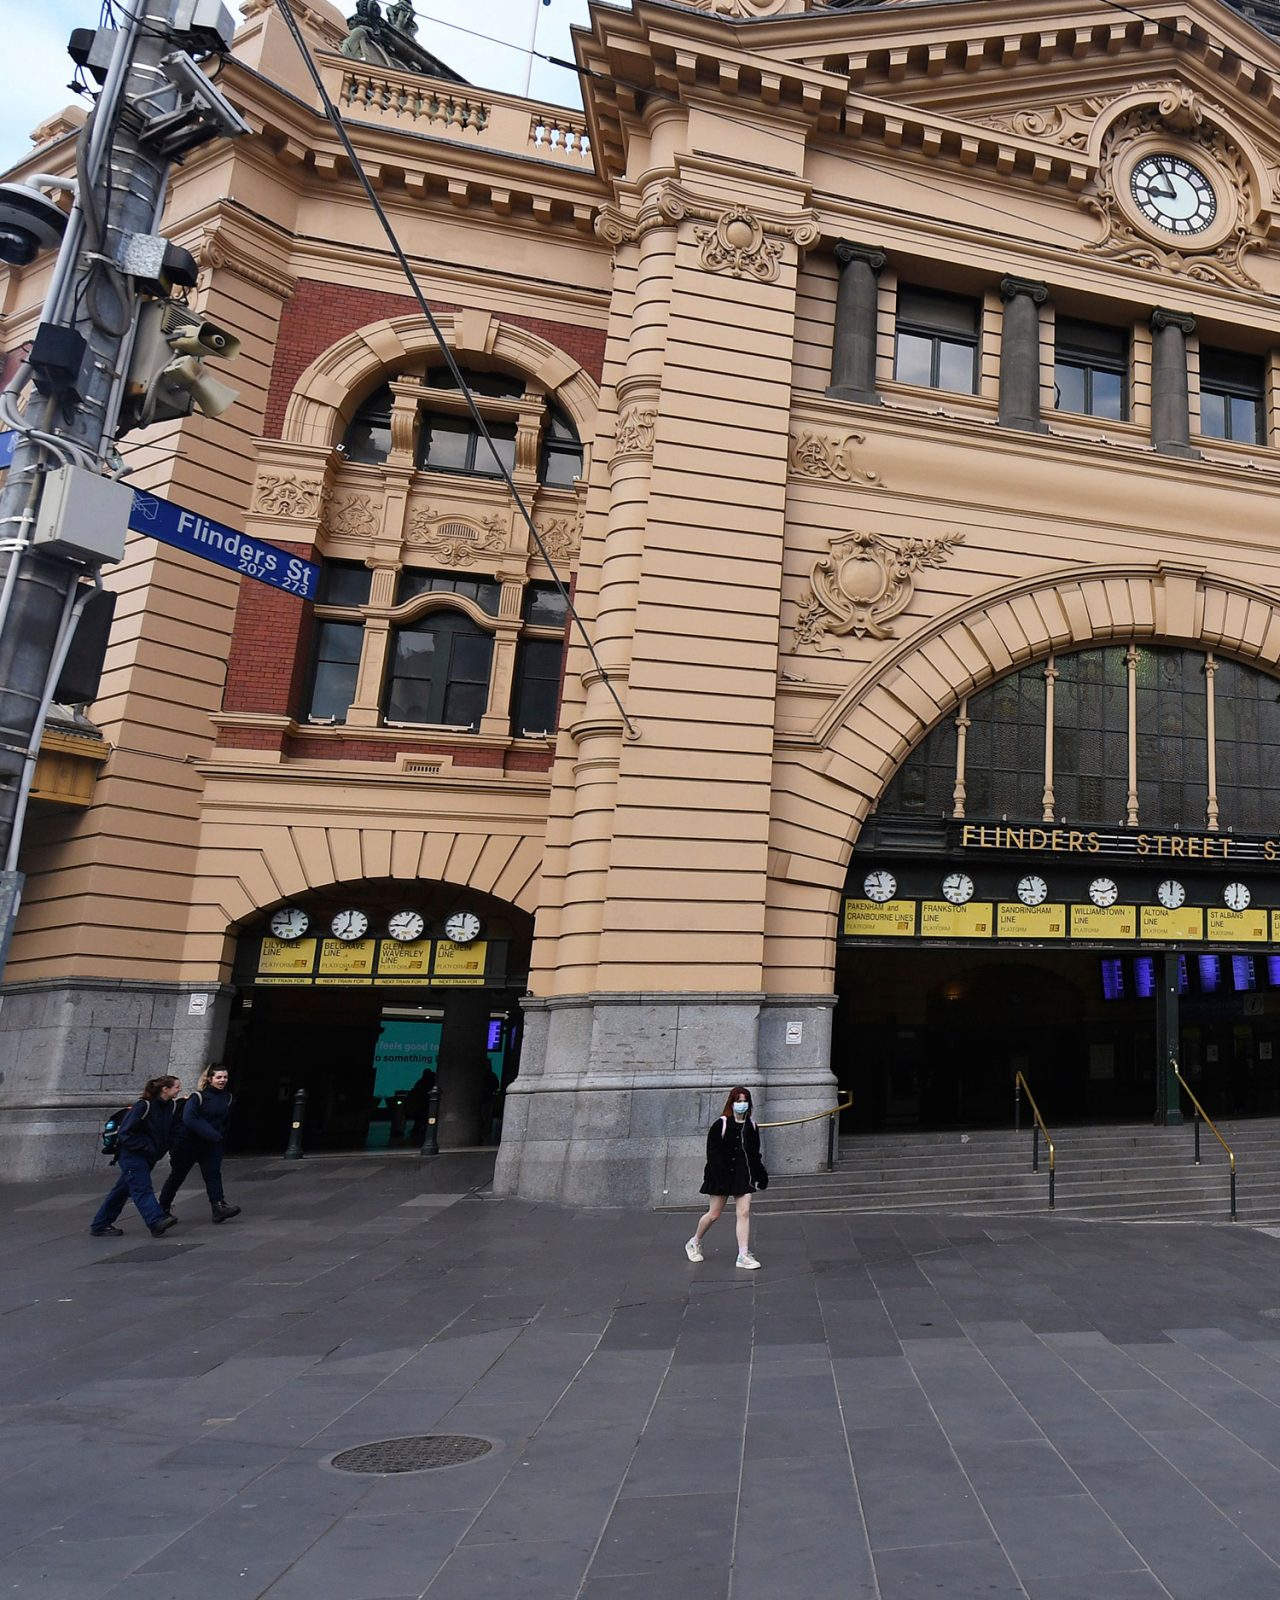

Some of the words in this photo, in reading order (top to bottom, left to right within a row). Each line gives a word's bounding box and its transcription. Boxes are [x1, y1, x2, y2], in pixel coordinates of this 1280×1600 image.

[176, 512, 278, 570] Flinders
[287, 558, 312, 585] St
[238, 560, 266, 578] 207
[282, 577, 308, 596] 273
[962, 825, 1100, 852] FLINDERS
[1136, 834, 1232, 858] STREET
[847, 902, 884, 911] PAKENHAM
[924, 904, 967, 913] FRANKSTON
[846, 913, 894, 921] CRANBOURNE
[264, 941, 301, 949] LILYDALE
[324, 942, 365, 950] BELGRAVE
[380, 1041, 402, 1050] feels
[404, 1041, 428, 1052] good
[384, 1054, 433, 1064] something
